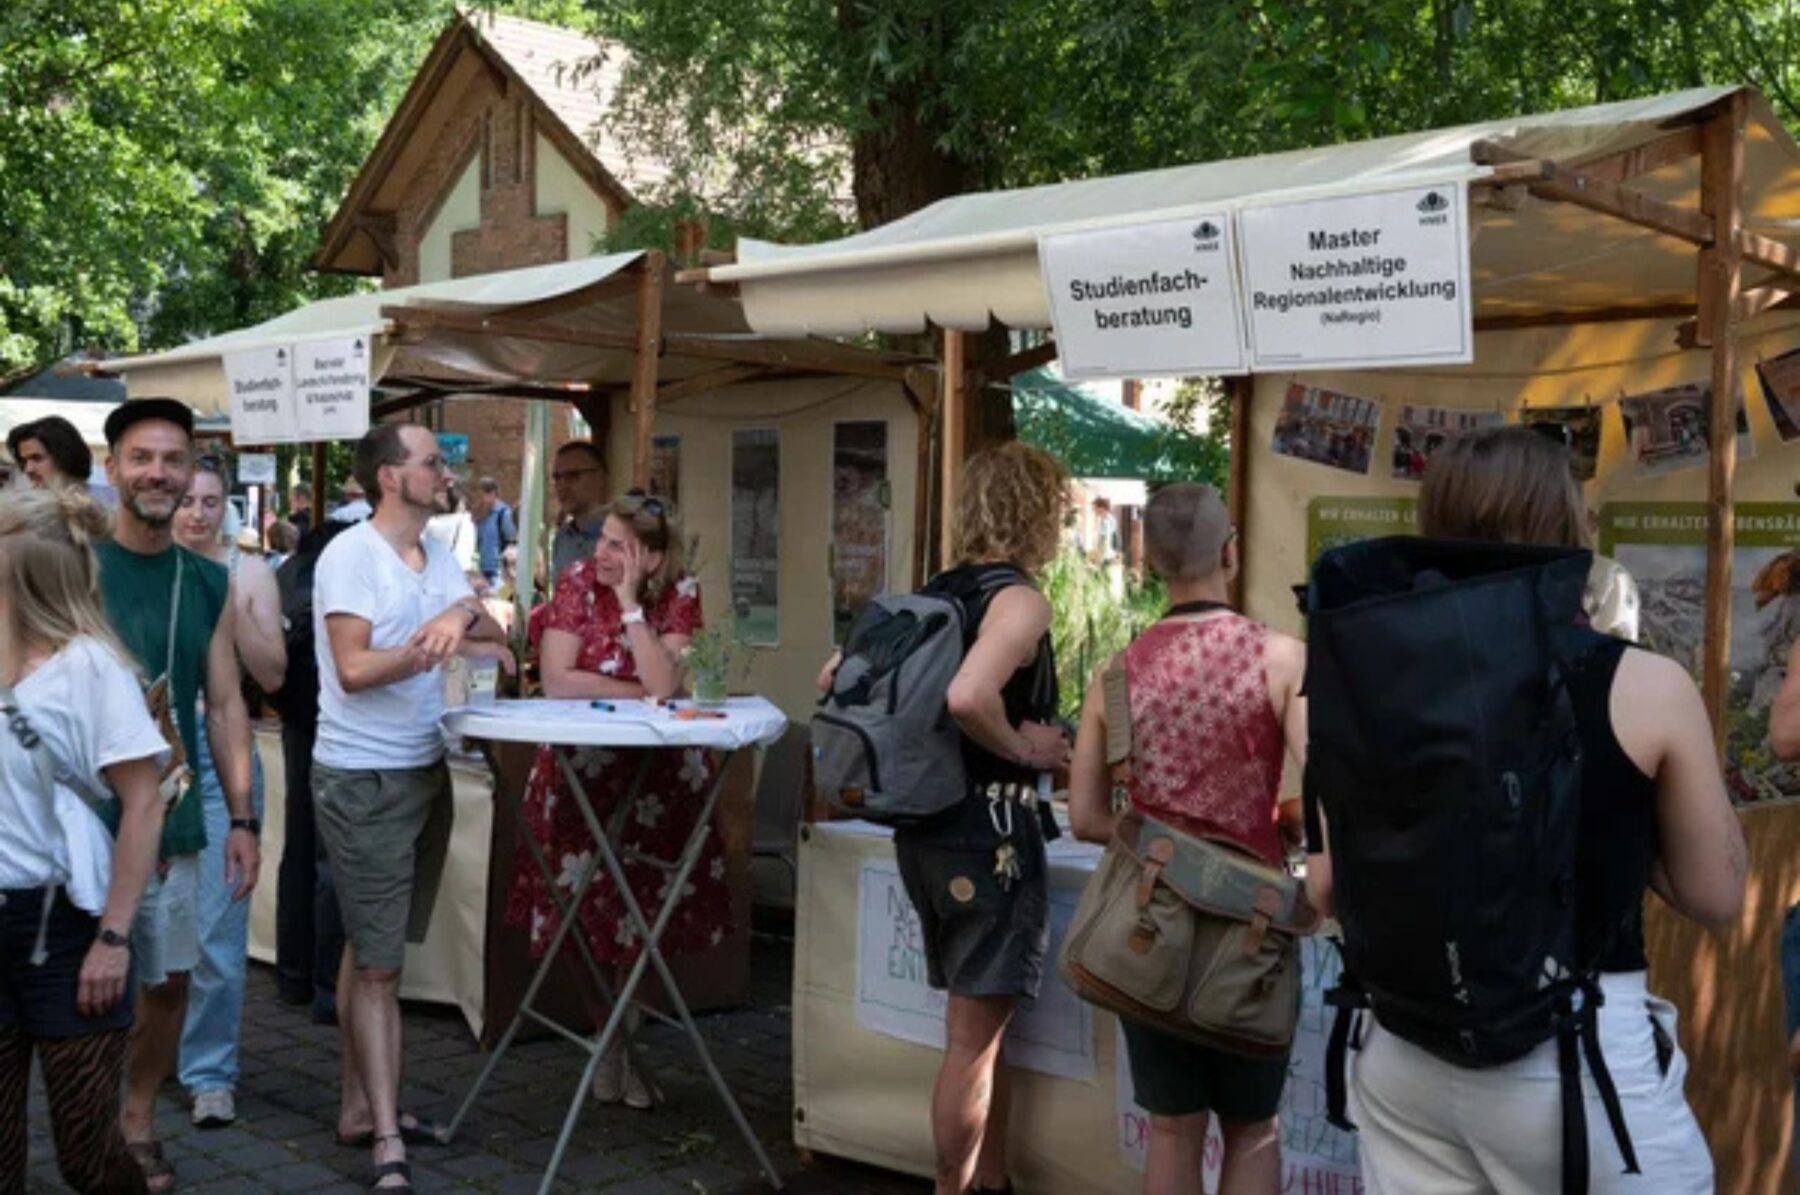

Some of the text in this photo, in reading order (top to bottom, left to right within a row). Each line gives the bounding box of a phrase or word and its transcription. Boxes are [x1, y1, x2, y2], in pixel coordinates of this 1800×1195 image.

[1308, 228, 1382, 251] Master
[1290, 255, 1407, 281] Nachhaltige
[1069, 268, 1208, 302] Studienfach-
[1253, 279, 1456, 312] Regionalentwicklung
[1094, 304, 1193, 330] beratung
[1320, 310, 1382, 325] (NaRegio)
